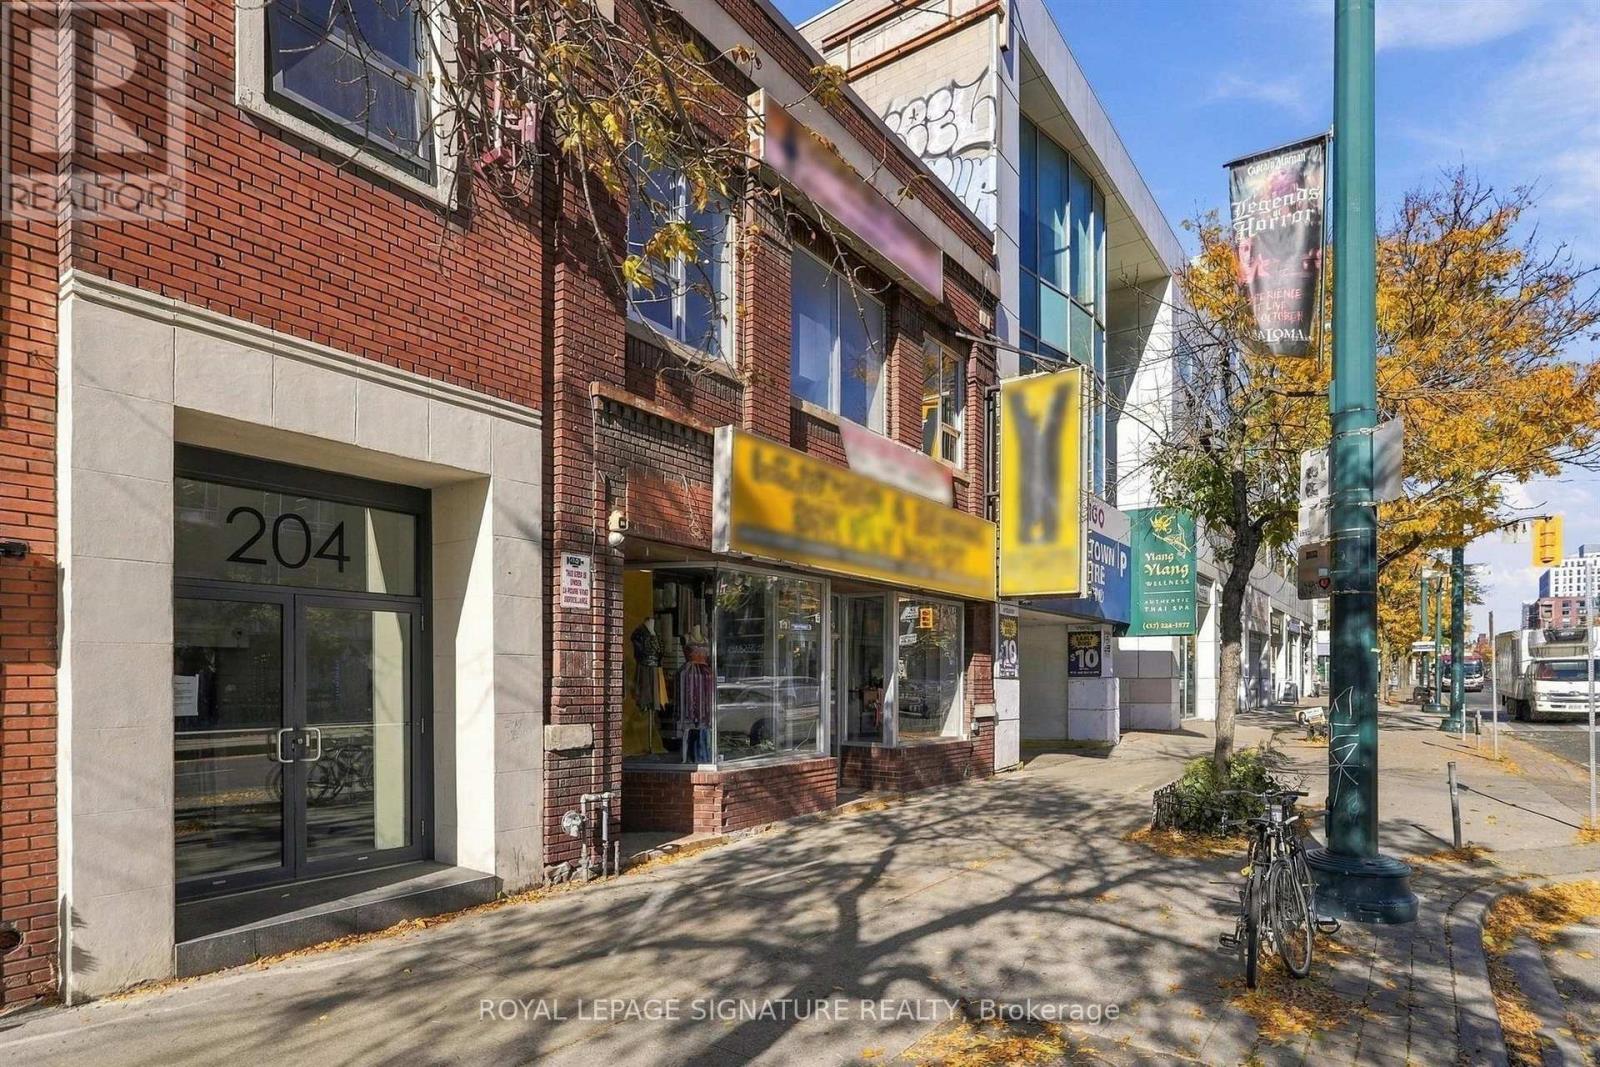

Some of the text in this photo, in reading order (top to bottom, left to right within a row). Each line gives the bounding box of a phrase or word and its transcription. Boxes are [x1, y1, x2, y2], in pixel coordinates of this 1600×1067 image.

[1232, 183, 1320, 221] Legends
[1233, 209, 1315, 242] Horror
[226, 505, 351, 574] 204
[1144, 552, 1175, 563] Ylang
[1144, 563, 1190, 578] Ylang
[1145, 579, 1190, 587] WELLNESS
[1144, 597, 1190, 605] AUTHENTIC
[1070, 648, 1099, 668] $10
